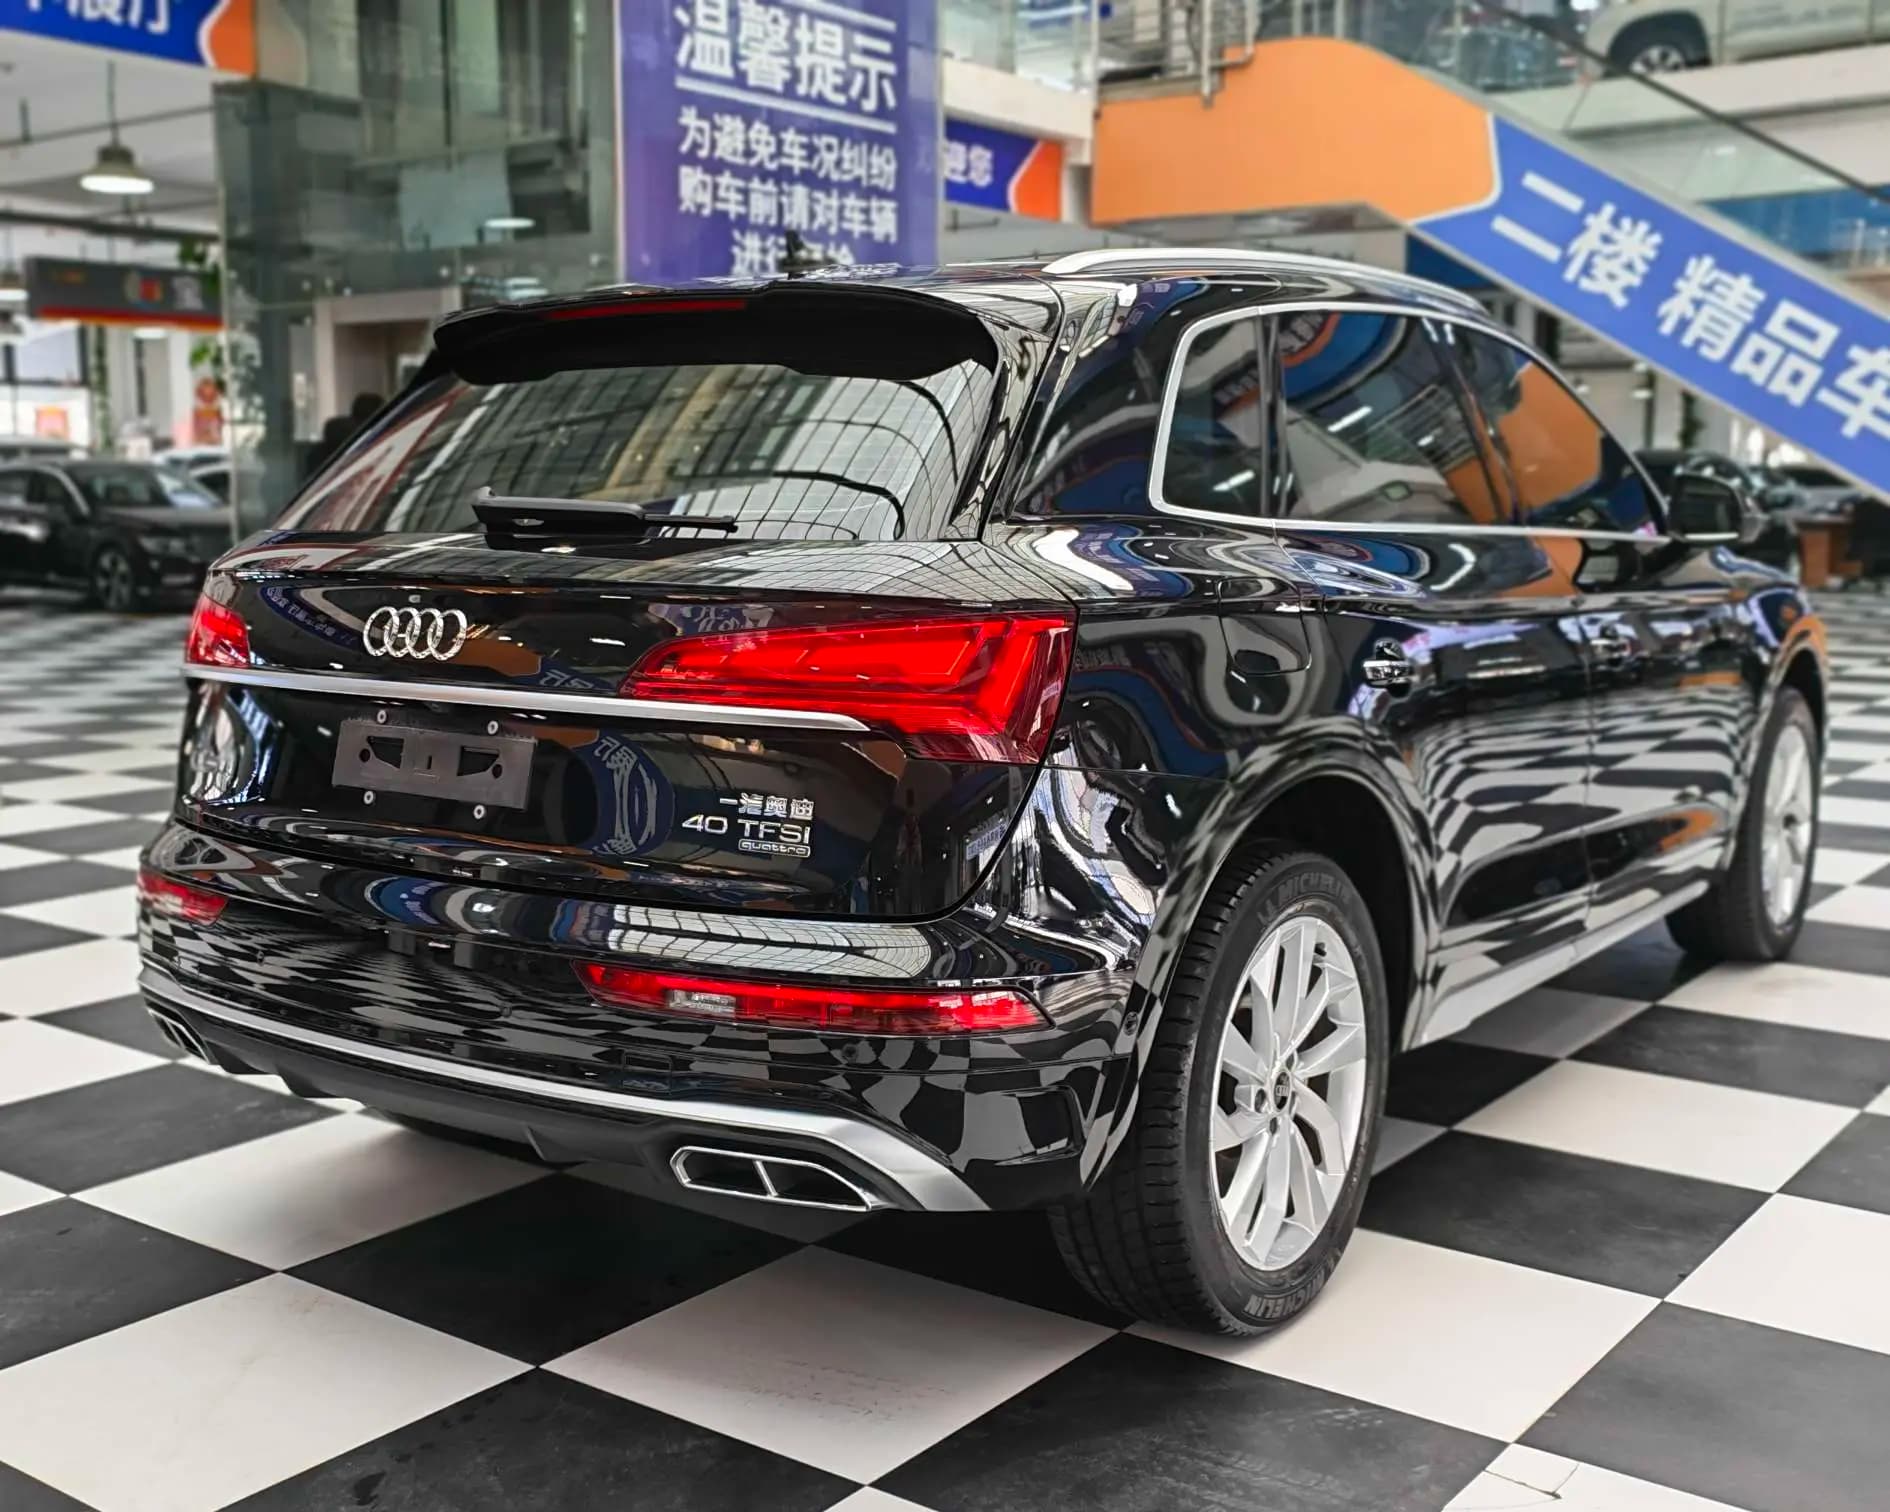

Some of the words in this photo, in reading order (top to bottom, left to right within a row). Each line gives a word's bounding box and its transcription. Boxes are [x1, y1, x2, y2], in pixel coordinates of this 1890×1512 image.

[674, 0, 897, 113] 温馨提示
[678, 104, 898, 192] 为避免车况纠纷
[679, 165, 898, 244] 购车前请对车辆
[1491, 171, 1664, 310] 二楼
[1655, 255, 1890, 439] 精品车
[681, 814, 729, 835] 40
[737, 818, 811, 845] TFSI
[719, 792, 815, 820] 一汽奥迪
[740, 840, 808, 856] quattro
